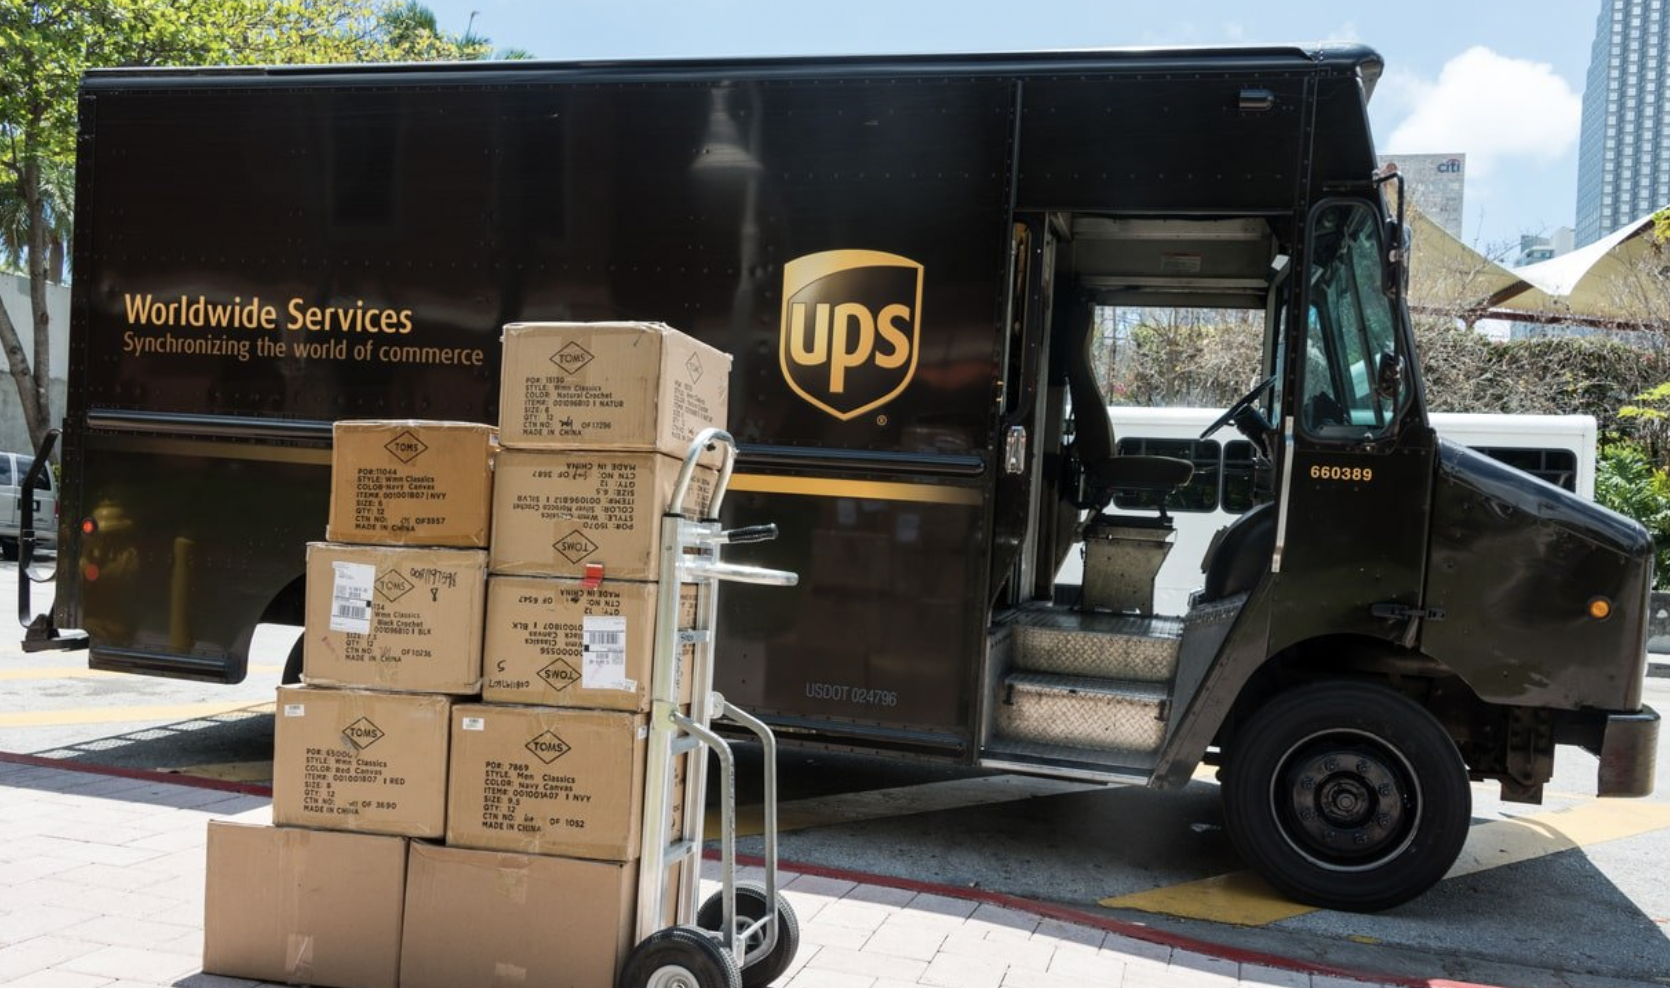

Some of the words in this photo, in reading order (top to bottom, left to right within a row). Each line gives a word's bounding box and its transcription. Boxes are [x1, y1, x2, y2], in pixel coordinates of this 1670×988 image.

[1437, 161, 1460, 173] citi
[124, 293, 277, 329] Worldwide
[287, 297, 413, 334] Services
[123, 331, 250, 362] Synchronizing
[256, 336, 286, 357] the
[293, 338, 347, 360] world
[354, 339, 374, 361] of
[379, 345, 484, 366] commerce
[790, 302, 910, 393] ups
[559, 353, 586, 364] TOMS
[584, 392, 613, 400] Crochet
[522, 428, 543, 436] MADE
[394, 442, 419, 452] TOMS
[566, 462, 593, 471] CHINA
[611, 463, 636, 471] MADE
[1310, 465, 1373, 481] 660389
[357, 476, 383, 484] STYLE:
[615, 480, 636, 489] QTY:
[408, 483, 436, 491] Canvas
[430, 492, 447, 500] NVY
[512, 503, 540, 511] Crochet
[543, 504, 572, 512] Morocco
[574, 505, 595, 513] Silver
[355, 523, 376, 531] MADE
[582, 522, 608, 530] 15070
[562, 542, 589, 552] TOMS
[379, 581, 405, 591] TOMS
[560, 589, 584, 597] CHINA
[600, 590, 620, 598] MADE
[377, 619, 394, 627] Black
[512, 622, 529, 630] BLK
[529, 631, 558, 639] Canvas
[524, 638, 557, 647] Classics
[380, 655, 402, 663] CHINA
[544, 669, 575, 679] TOMS
[806, 682, 850, 701] USDOT
[851, 687, 898, 707] 024796
[350, 727, 378, 738] TOMS
[533, 742, 563, 753] TOMS
[356, 759, 388, 768] Classics
[508, 763, 529, 771] 7869
[305, 765, 332, 773] COLOR:
[354, 768, 382, 776] Canvas
[517, 772, 534, 780] Men
[542, 773, 576, 784] Classics
[304, 781, 323, 789] SIZE:
[484, 779, 514, 787] COLOR:
[519, 782, 539, 791] Navy
[543, 783, 573, 792] Canvas
[304, 789, 321, 797] QTY:
[484, 795, 503, 803] SIZE:
[507, 797, 520, 806] 9.5
[573, 793, 591, 803] NVY
[303, 805, 324, 813] MADE
[336, 807, 359, 815] CHINA
[483, 804, 502, 812] QTY:
[483, 812, 498, 820] CTN
[549, 818, 560, 826] OF
[565, 818, 585, 828] 1052
[482, 821, 503, 830] MADE
[506, 823, 514, 831] IN
[517, 824, 541, 832] CHINA
